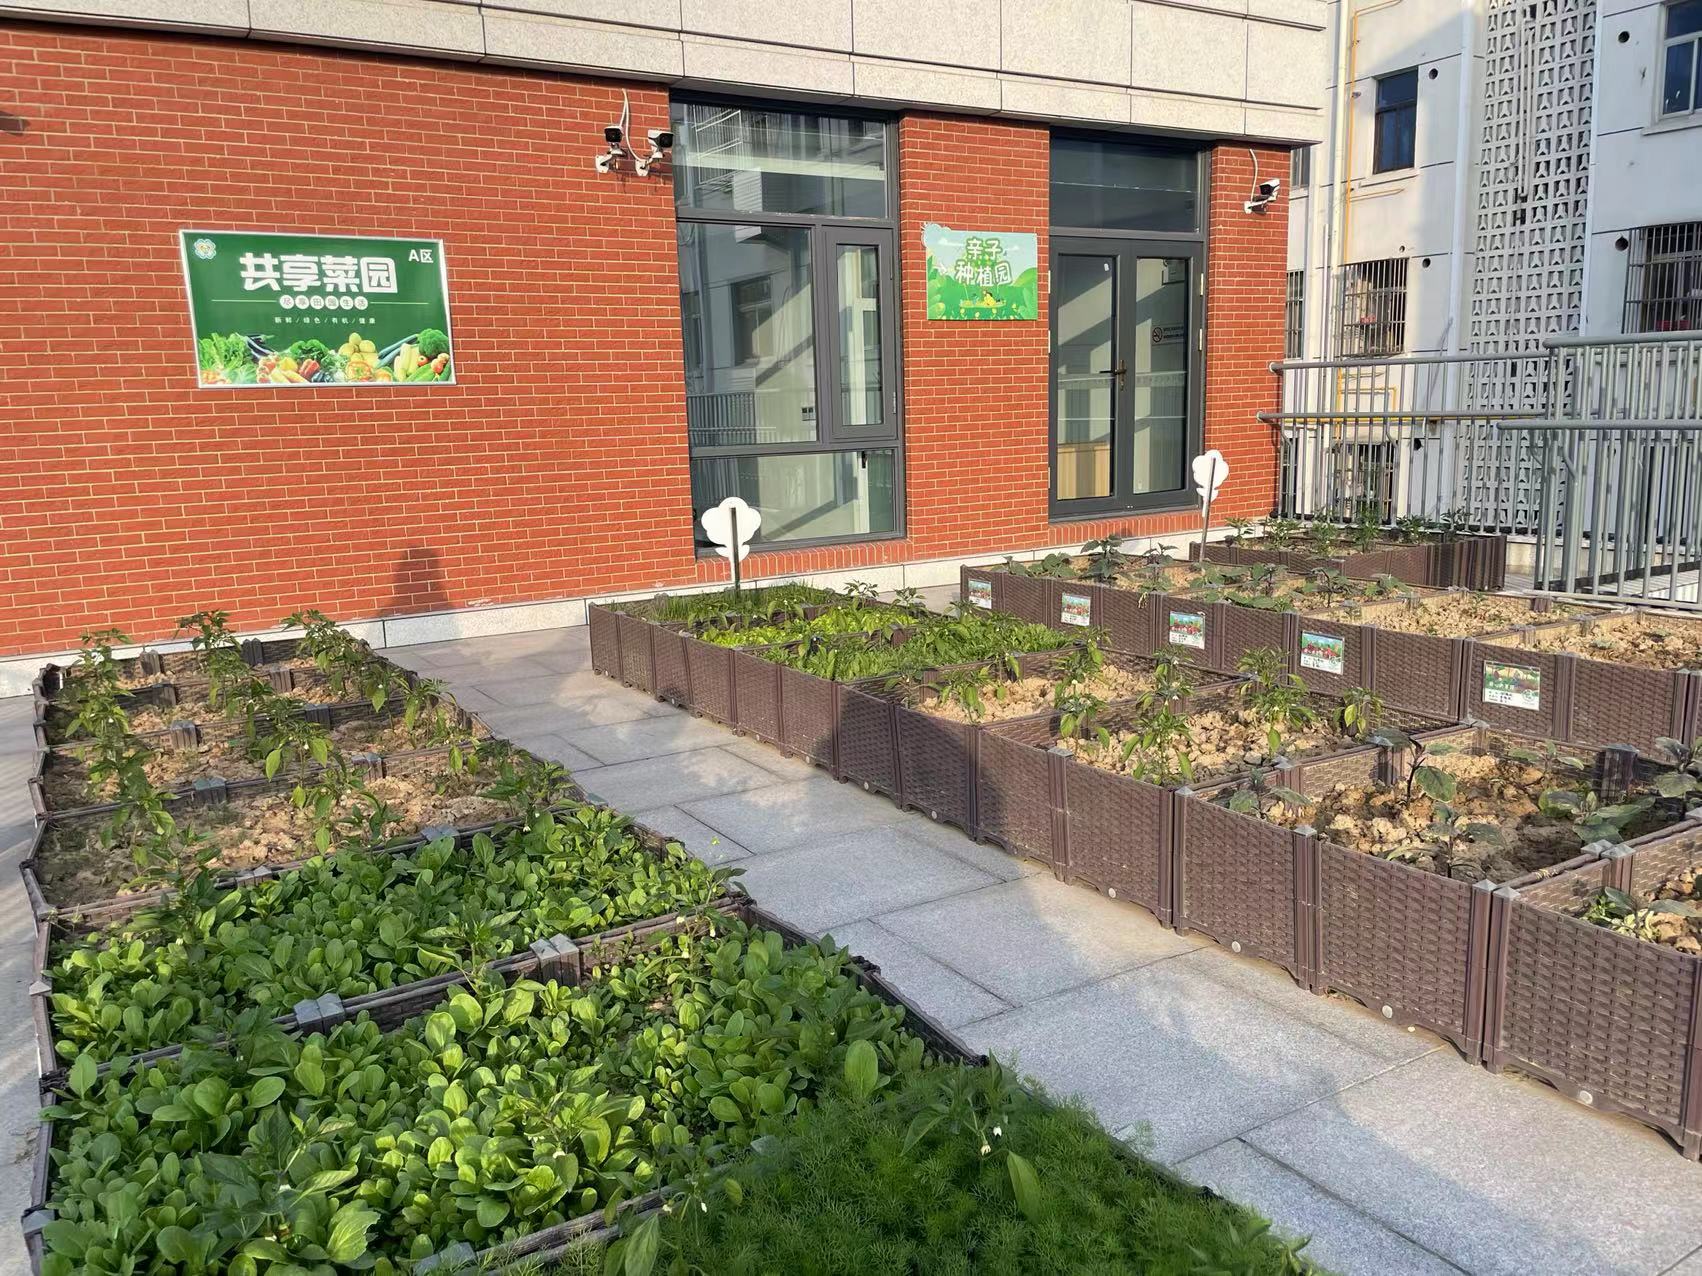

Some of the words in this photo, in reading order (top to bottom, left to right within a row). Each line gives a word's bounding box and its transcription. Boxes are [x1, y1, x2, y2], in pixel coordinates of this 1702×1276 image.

[408, 249, 434, 263] A区
[966, 238, 1002, 260] 亲子
[239, 252, 399, 294] 共享菜园
[956, 259, 1012, 287] 种植园
